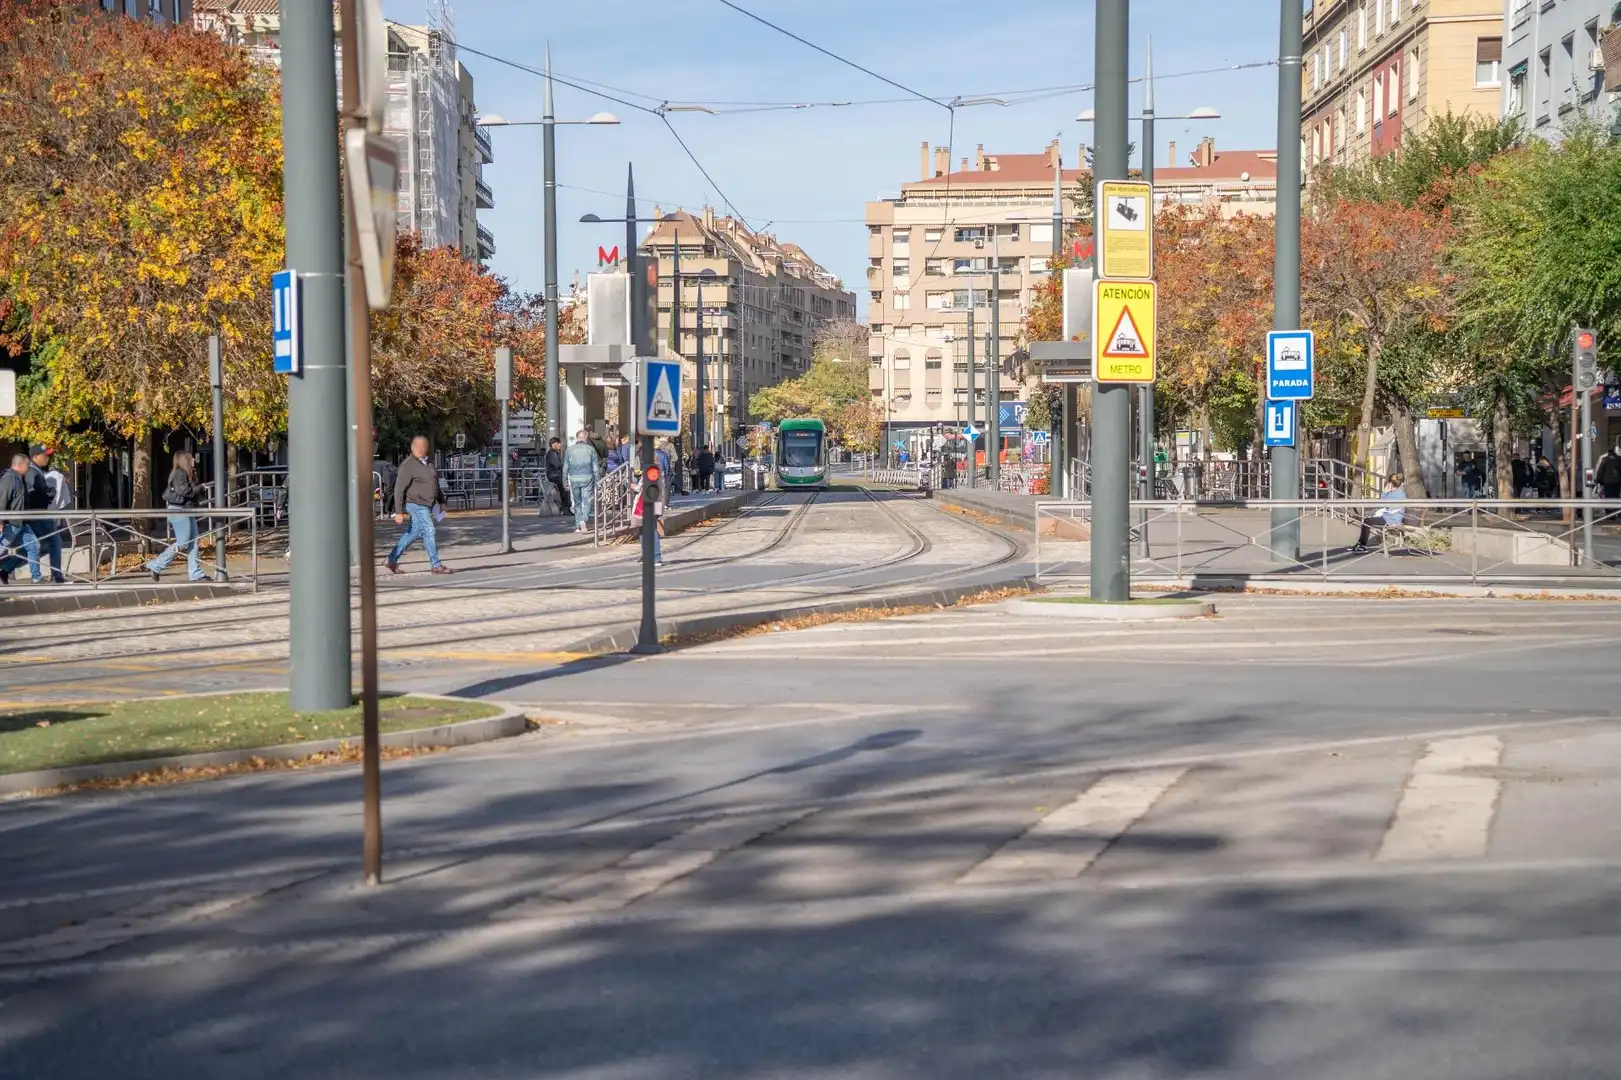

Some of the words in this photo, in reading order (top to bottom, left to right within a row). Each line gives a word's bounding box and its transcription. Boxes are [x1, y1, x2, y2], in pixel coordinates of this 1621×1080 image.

[598, 246, 618, 266] M
[1074, 240, 1094, 262] M
[1103, 286, 1150, 299] ATENCIÓN
[1110, 365, 1142, 374] METRO
[1272, 379, 1309, 387] PARADA
[1275, 413, 1283, 426] 1
